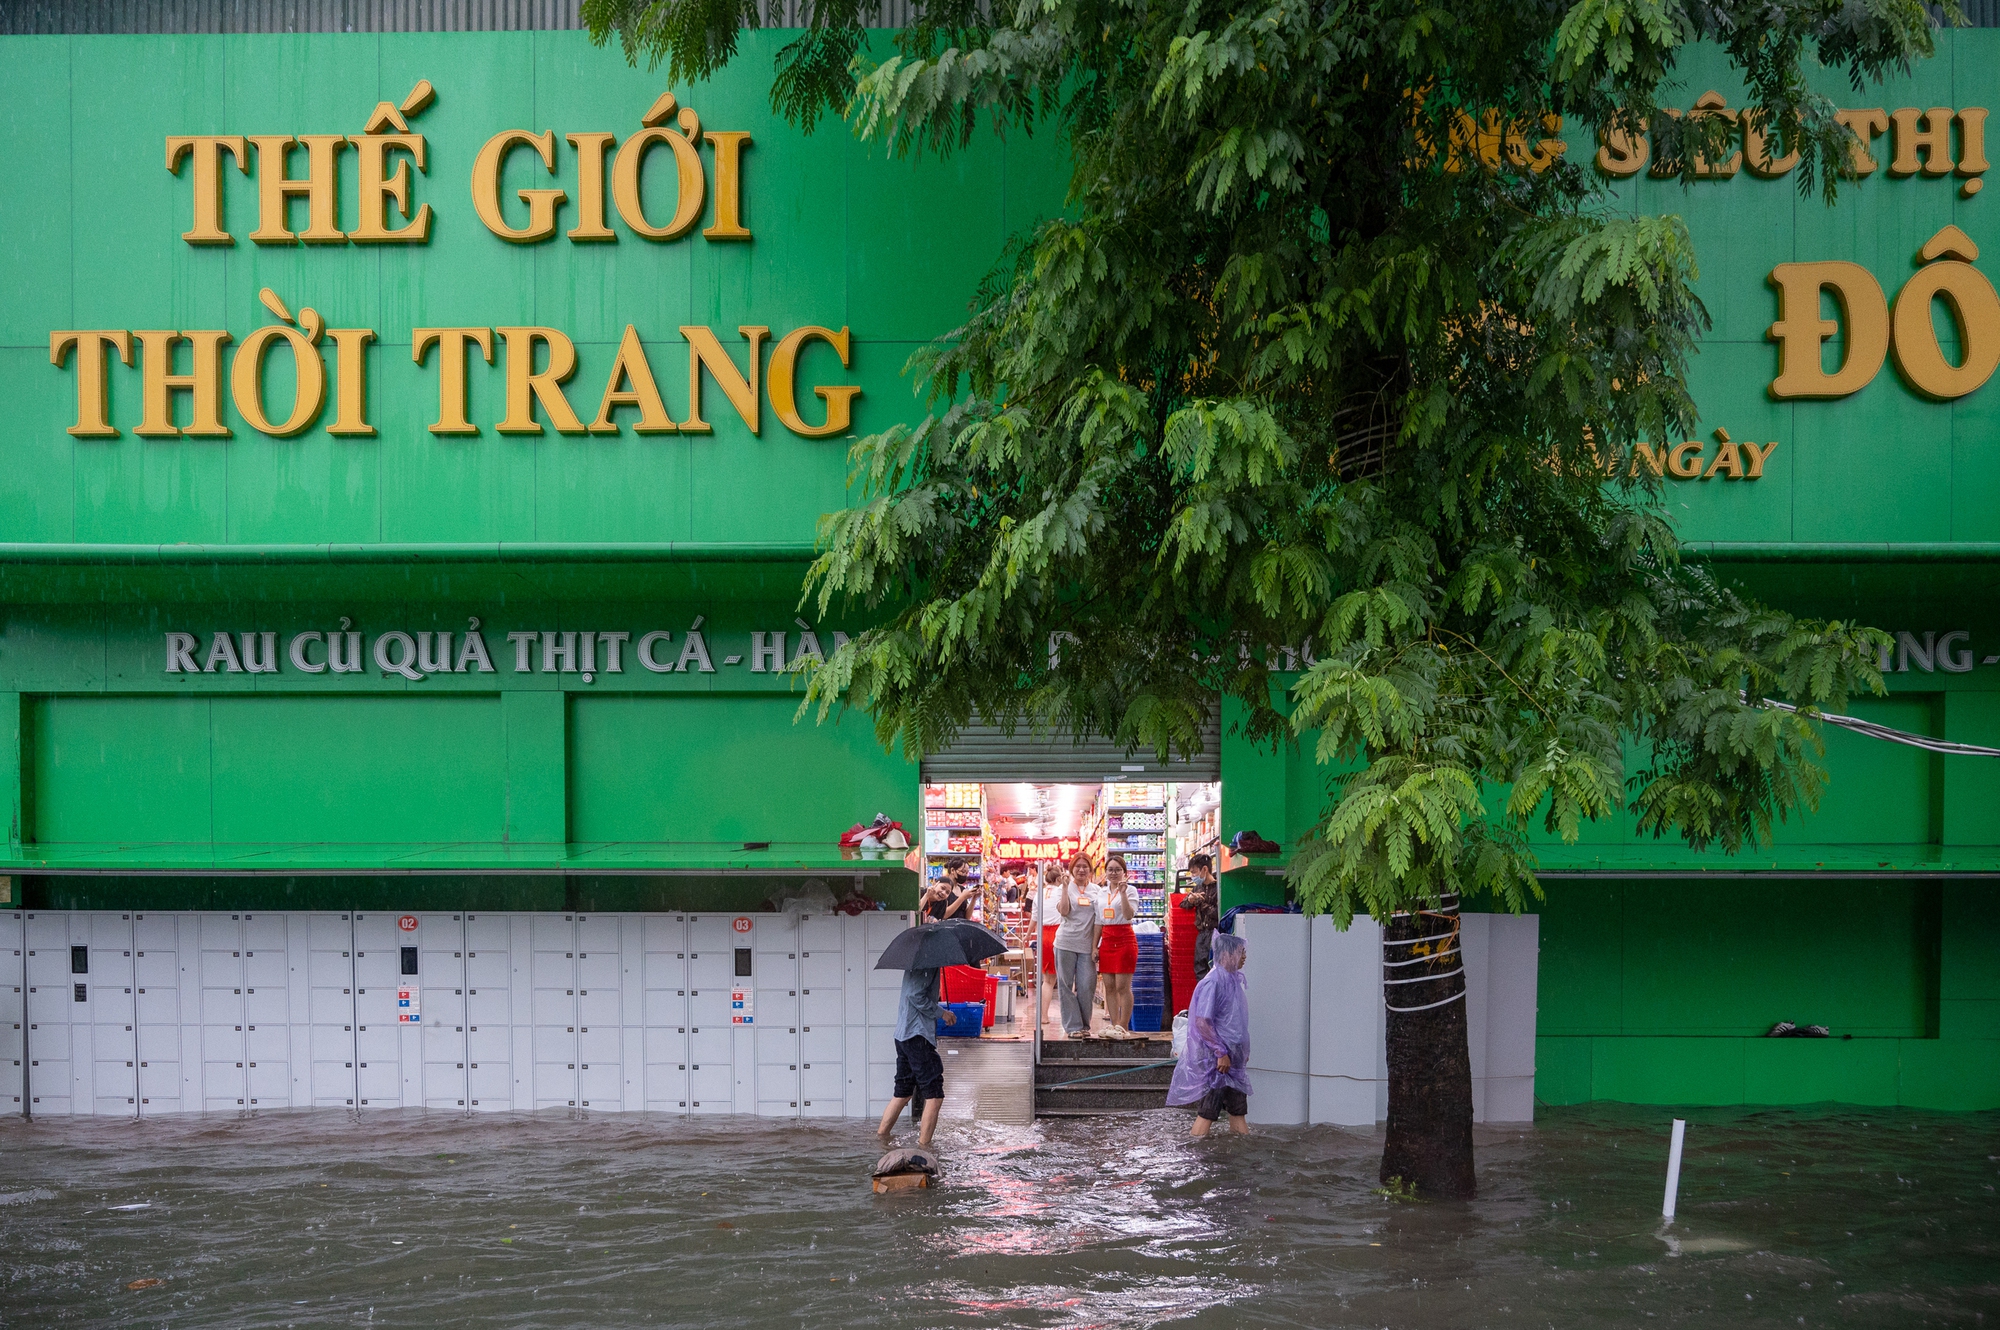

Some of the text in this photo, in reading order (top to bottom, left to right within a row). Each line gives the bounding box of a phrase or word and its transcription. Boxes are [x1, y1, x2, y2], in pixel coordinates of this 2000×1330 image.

[166, 79, 754, 247] THẾ GIỚI
[1767, 224, 2000, 401] ĐÔ
[50, 288, 862, 439] THỜI TRANG
[165, 631, 278, 674] RAU
[289, 616, 362, 674] CỦ
[374, 616, 496, 681] QUẢ
[507, 631, 630, 684] THỊT
[637, 614, 712, 674] CÁ
[1022, 844, 1058, 858] TRANG
[401, 918, 415, 929] 02
[735, 919, 749, 931] 03
